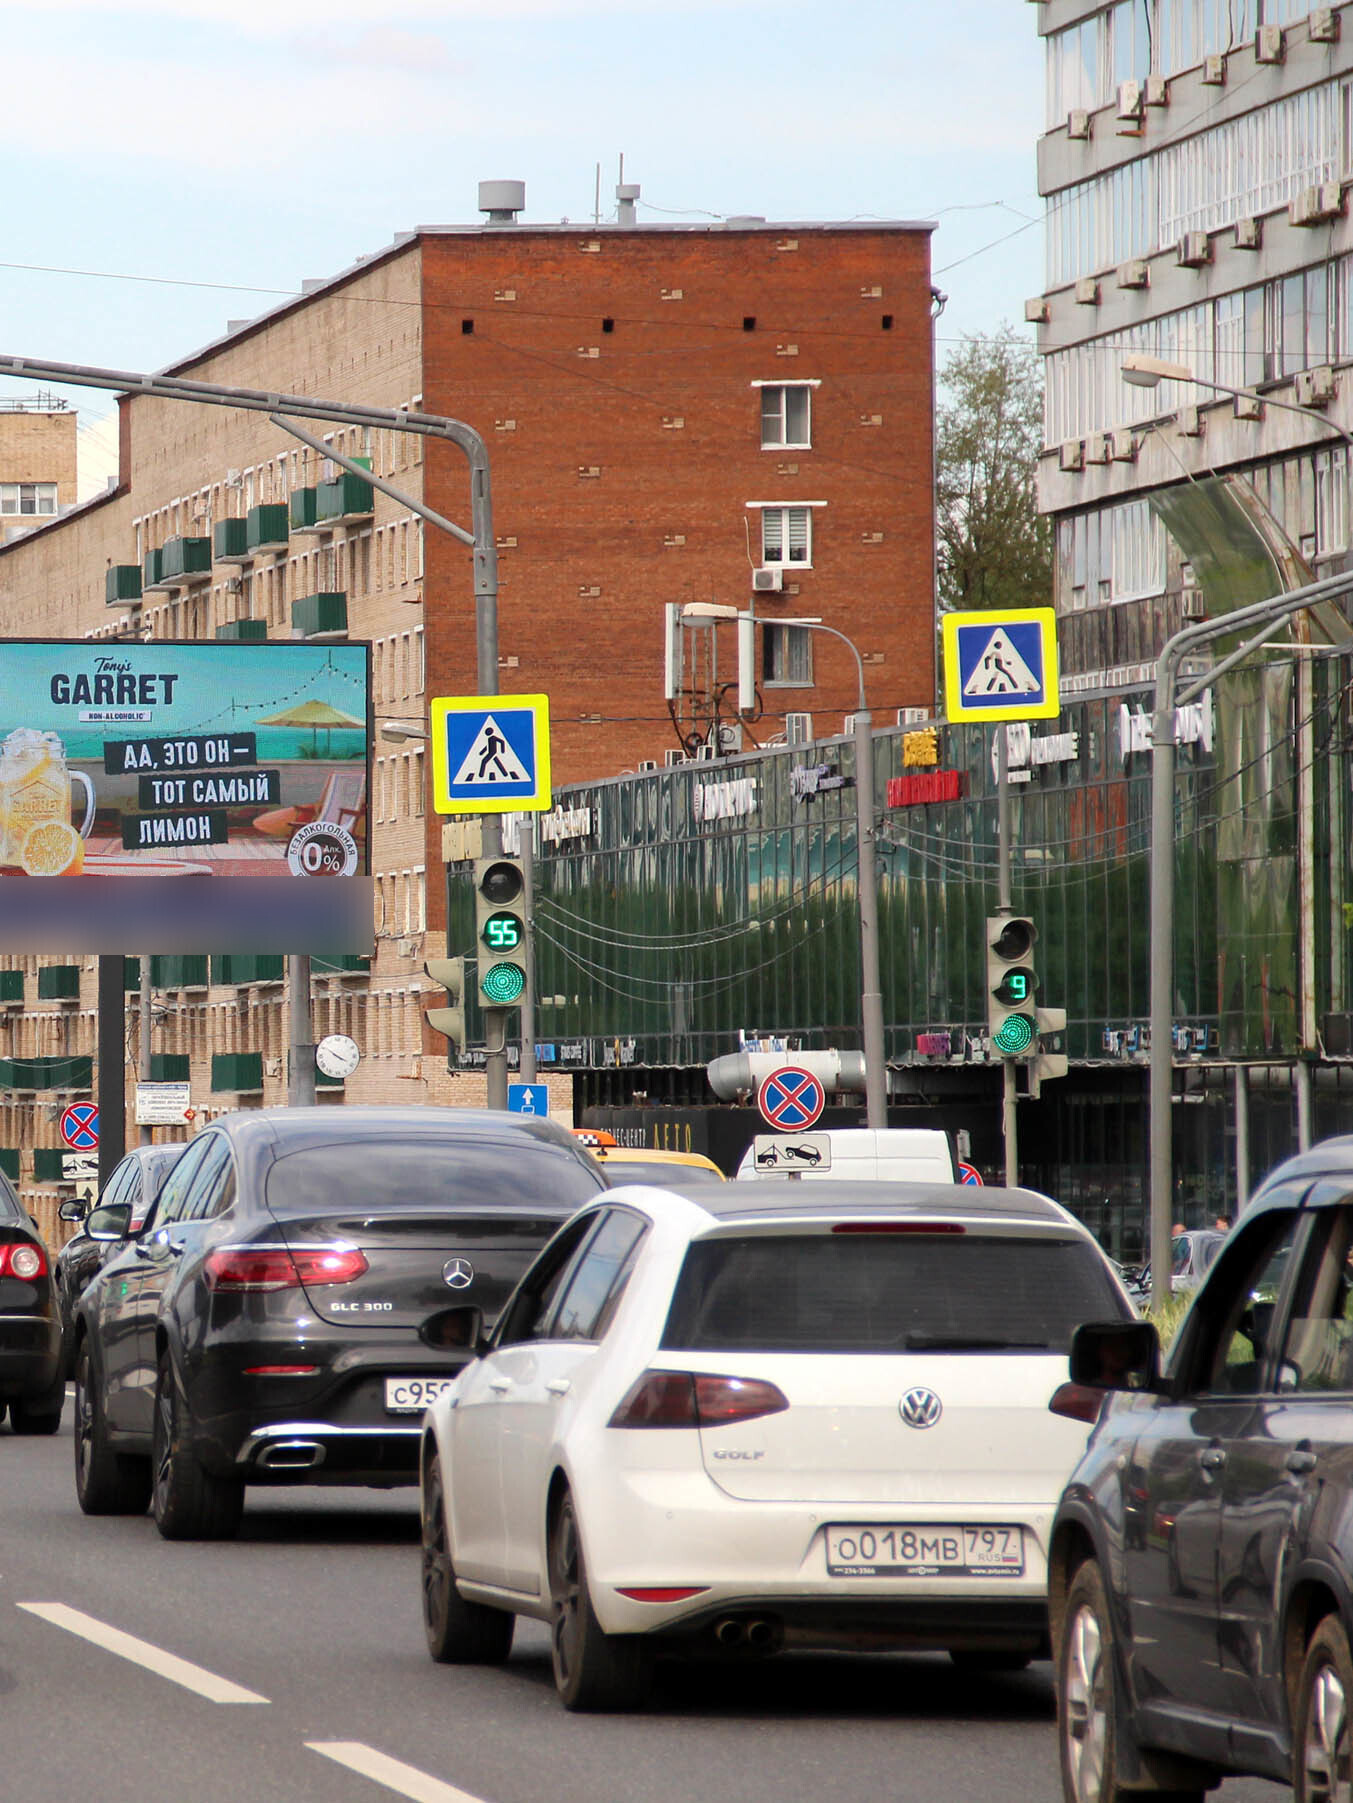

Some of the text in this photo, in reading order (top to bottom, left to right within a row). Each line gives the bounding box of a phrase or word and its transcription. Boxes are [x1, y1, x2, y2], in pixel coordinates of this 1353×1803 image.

[94, 656, 132, 673] Tony's
[50, 673, 179, 705] GARRET
[88, 712, 144, 720] NON-ALCOHOLIC
[163, 741, 198, 766] ЭТО
[152, 773, 269, 805] ТОТ САМЫЙ
[139, 815, 211, 844] ЛИМОН
[289, 823, 356, 856] БЕЗАЛКОГОЛЬНАЯ
[490, 920, 517, 946] 55
[1013, 975, 1025, 998] 9
[330, 1302, 393, 1311] GLC 300
[713, 1450, 766, 1460] GOLF
[838, 1530, 1011, 1561] О018МВ 797
[977, 1553, 1001, 1562] RUS
